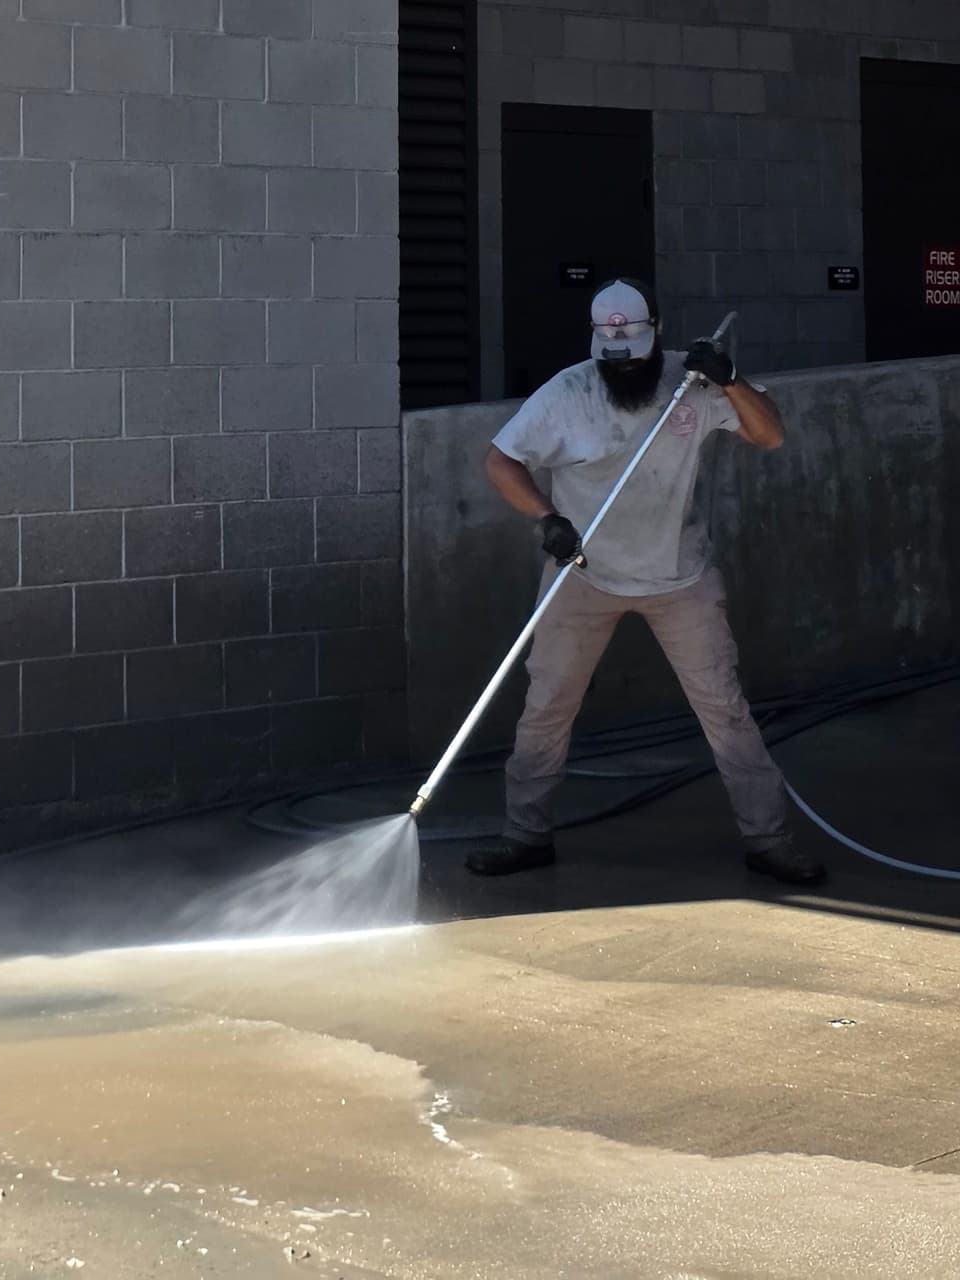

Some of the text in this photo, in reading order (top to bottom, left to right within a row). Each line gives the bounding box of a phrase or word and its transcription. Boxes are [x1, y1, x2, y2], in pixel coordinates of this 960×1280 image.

[929, 250, 955, 266] FIRE
[925, 269, 960, 286] RISER
[925, 289, 960, 305] ROOM
